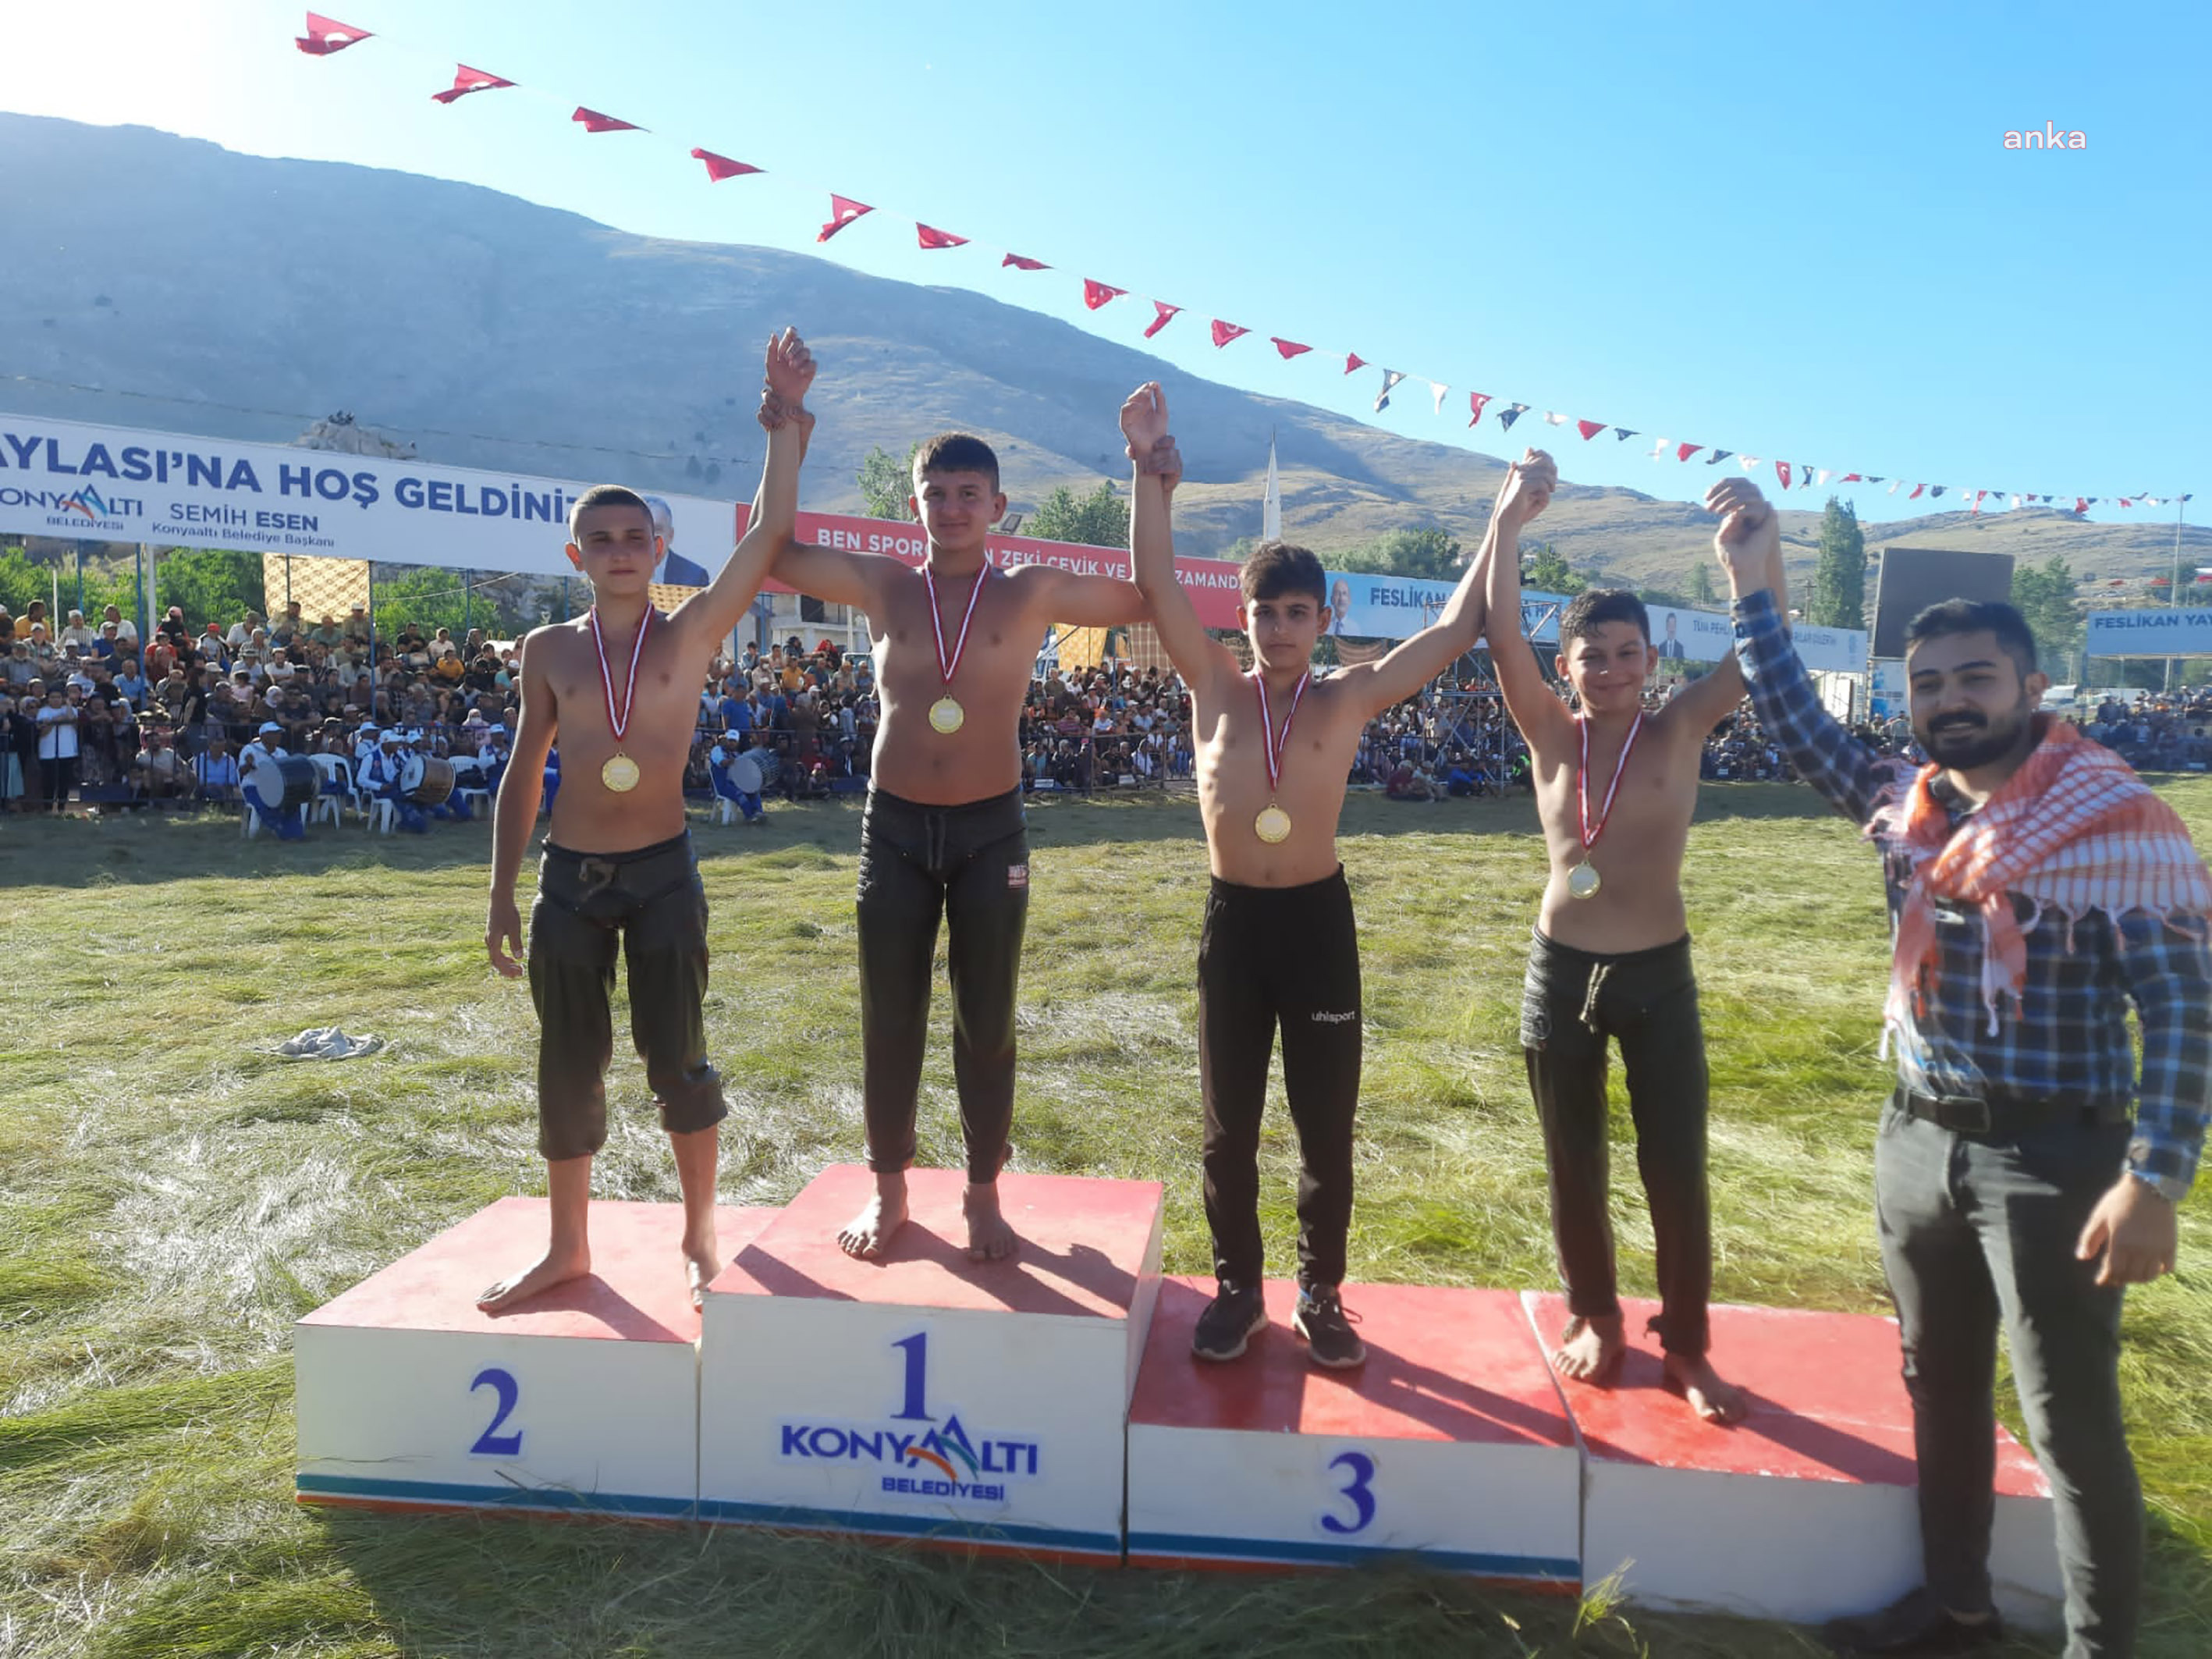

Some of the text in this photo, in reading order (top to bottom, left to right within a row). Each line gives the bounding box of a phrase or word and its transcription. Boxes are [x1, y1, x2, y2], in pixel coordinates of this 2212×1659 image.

[279, 464, 380, 510] HOŞ
[47, 516, 123, 531] BELEDİYESİ
[152, 522, 335, 548] Konyaaltı Belediye Başkanı
[170, 503, 318, 532] SEMİH ESEN
[818, 528, 861, 550] BEN
[1001, 549, 1041, 567] ZEKİ
[1105, 562, 1126, 579] VE
[2095, 613, 2179, 630] FESLİKAN
[1312, 1011, 1355, 1025] uhlsport
[890, 1331, 937, 1422] 1
[470, 1368, 523, 1456] 2
[782, 1414, 1038, 1478] KONYAALTI
[882, 1477, 1004, 1501] BELEDİYESİ
[1321, 1452, 1376, 1534] 3
